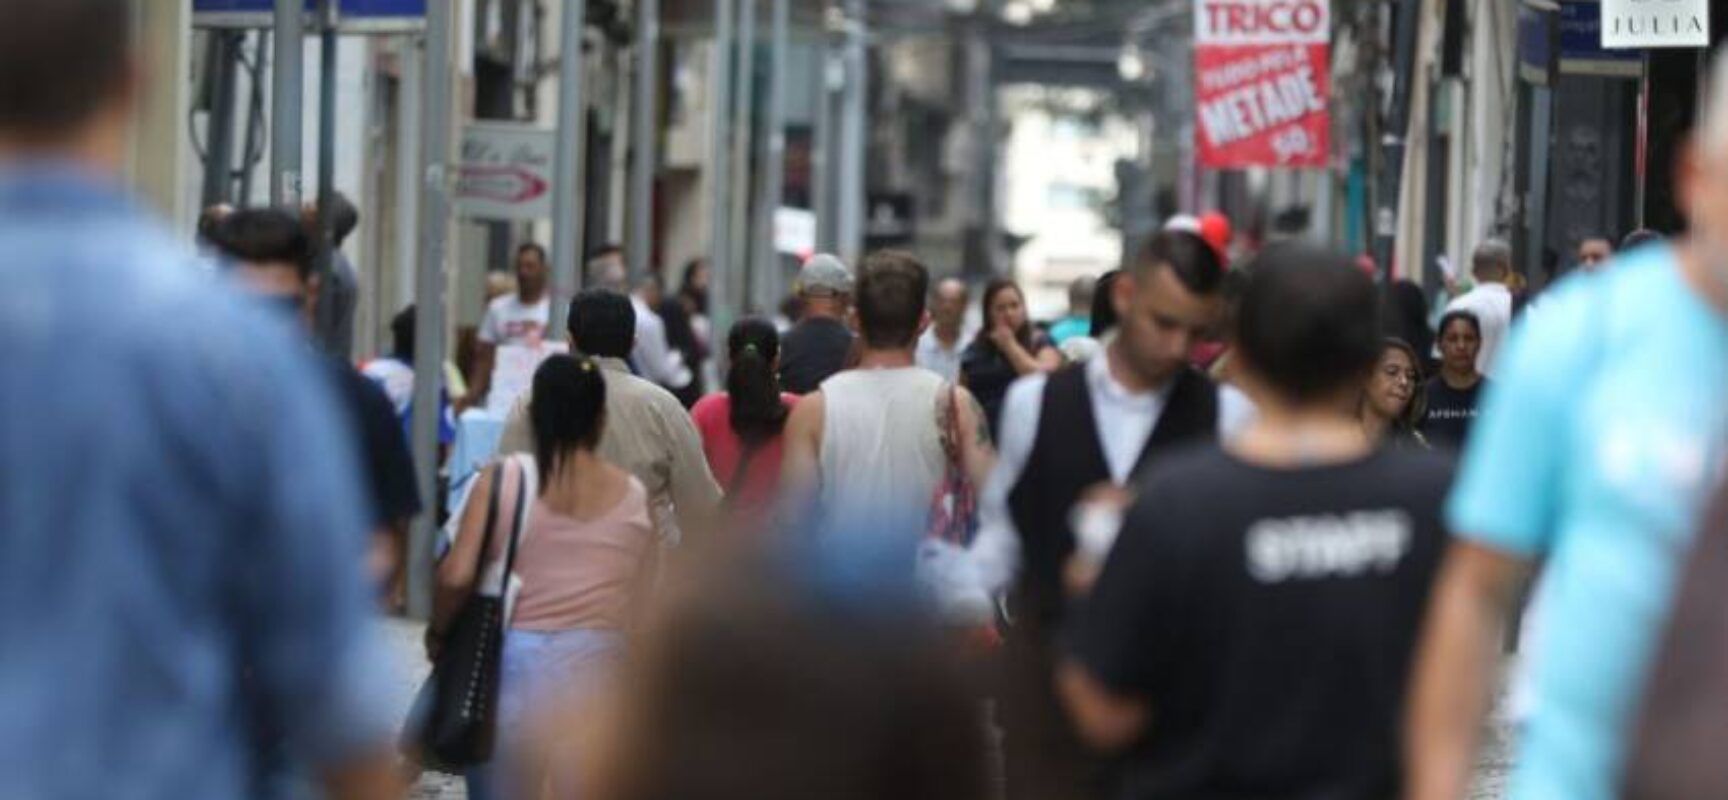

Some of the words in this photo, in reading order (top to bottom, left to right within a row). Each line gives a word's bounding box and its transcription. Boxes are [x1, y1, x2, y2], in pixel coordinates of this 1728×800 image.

[1206, 1, 1321, 32] TRICO
[1611, 15, 1703, 35] JULIA
[1200, 64, 1328, 146] METADE
[1246, 508, 1412, 583] STAFF
